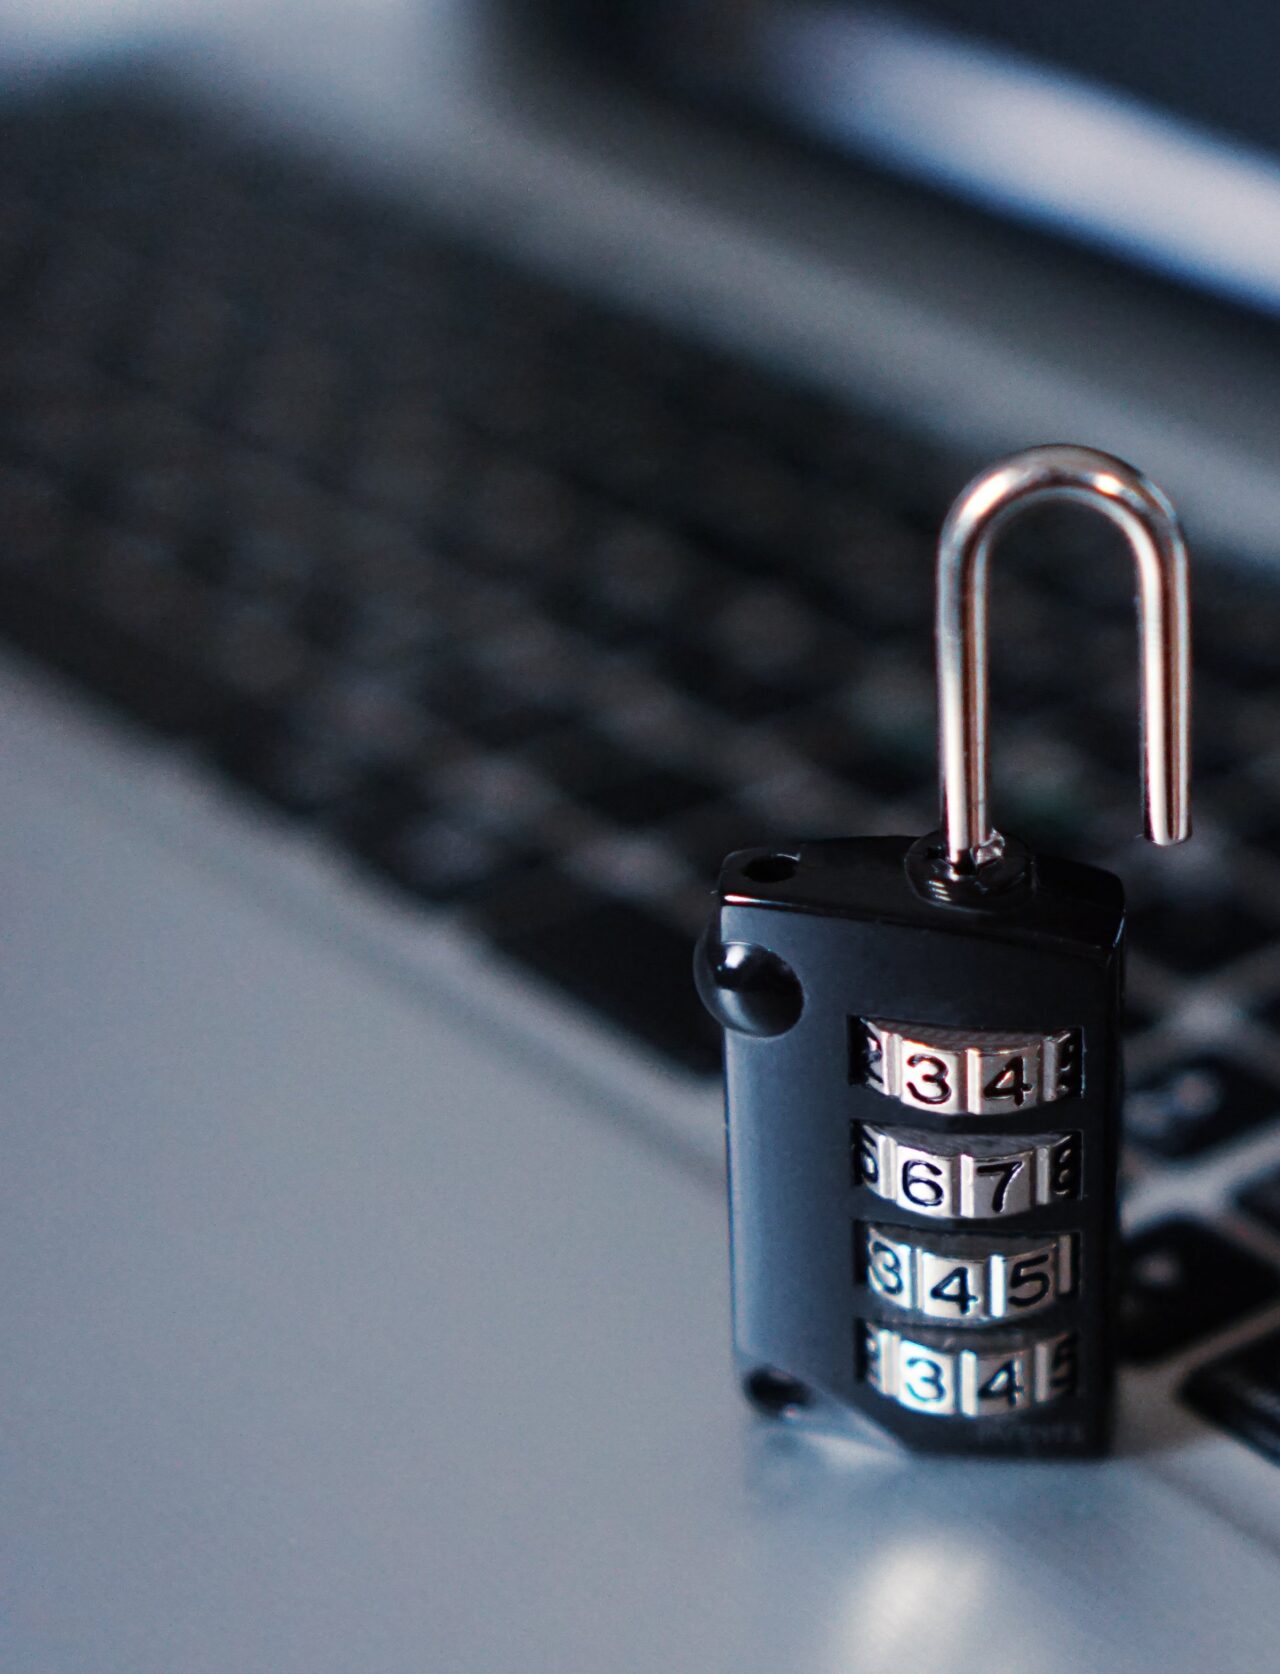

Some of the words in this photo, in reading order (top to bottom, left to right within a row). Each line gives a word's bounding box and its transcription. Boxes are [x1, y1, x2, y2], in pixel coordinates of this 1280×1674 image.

[906, 1053, 951, 1105] 3
[983, 1055, 1033, 1107] 4
[902, 1159, 944, 1207] 6
[976, 1160, 1024, 1214] 7
[870, 1240, 903, 1295] 3
[930, 1265, 978, 1315] 4
[1008, 1253, 1050, 1307] 5
[905, 1357, 946, 1402] 3
[977, 1359, 1024, 1406] 4
